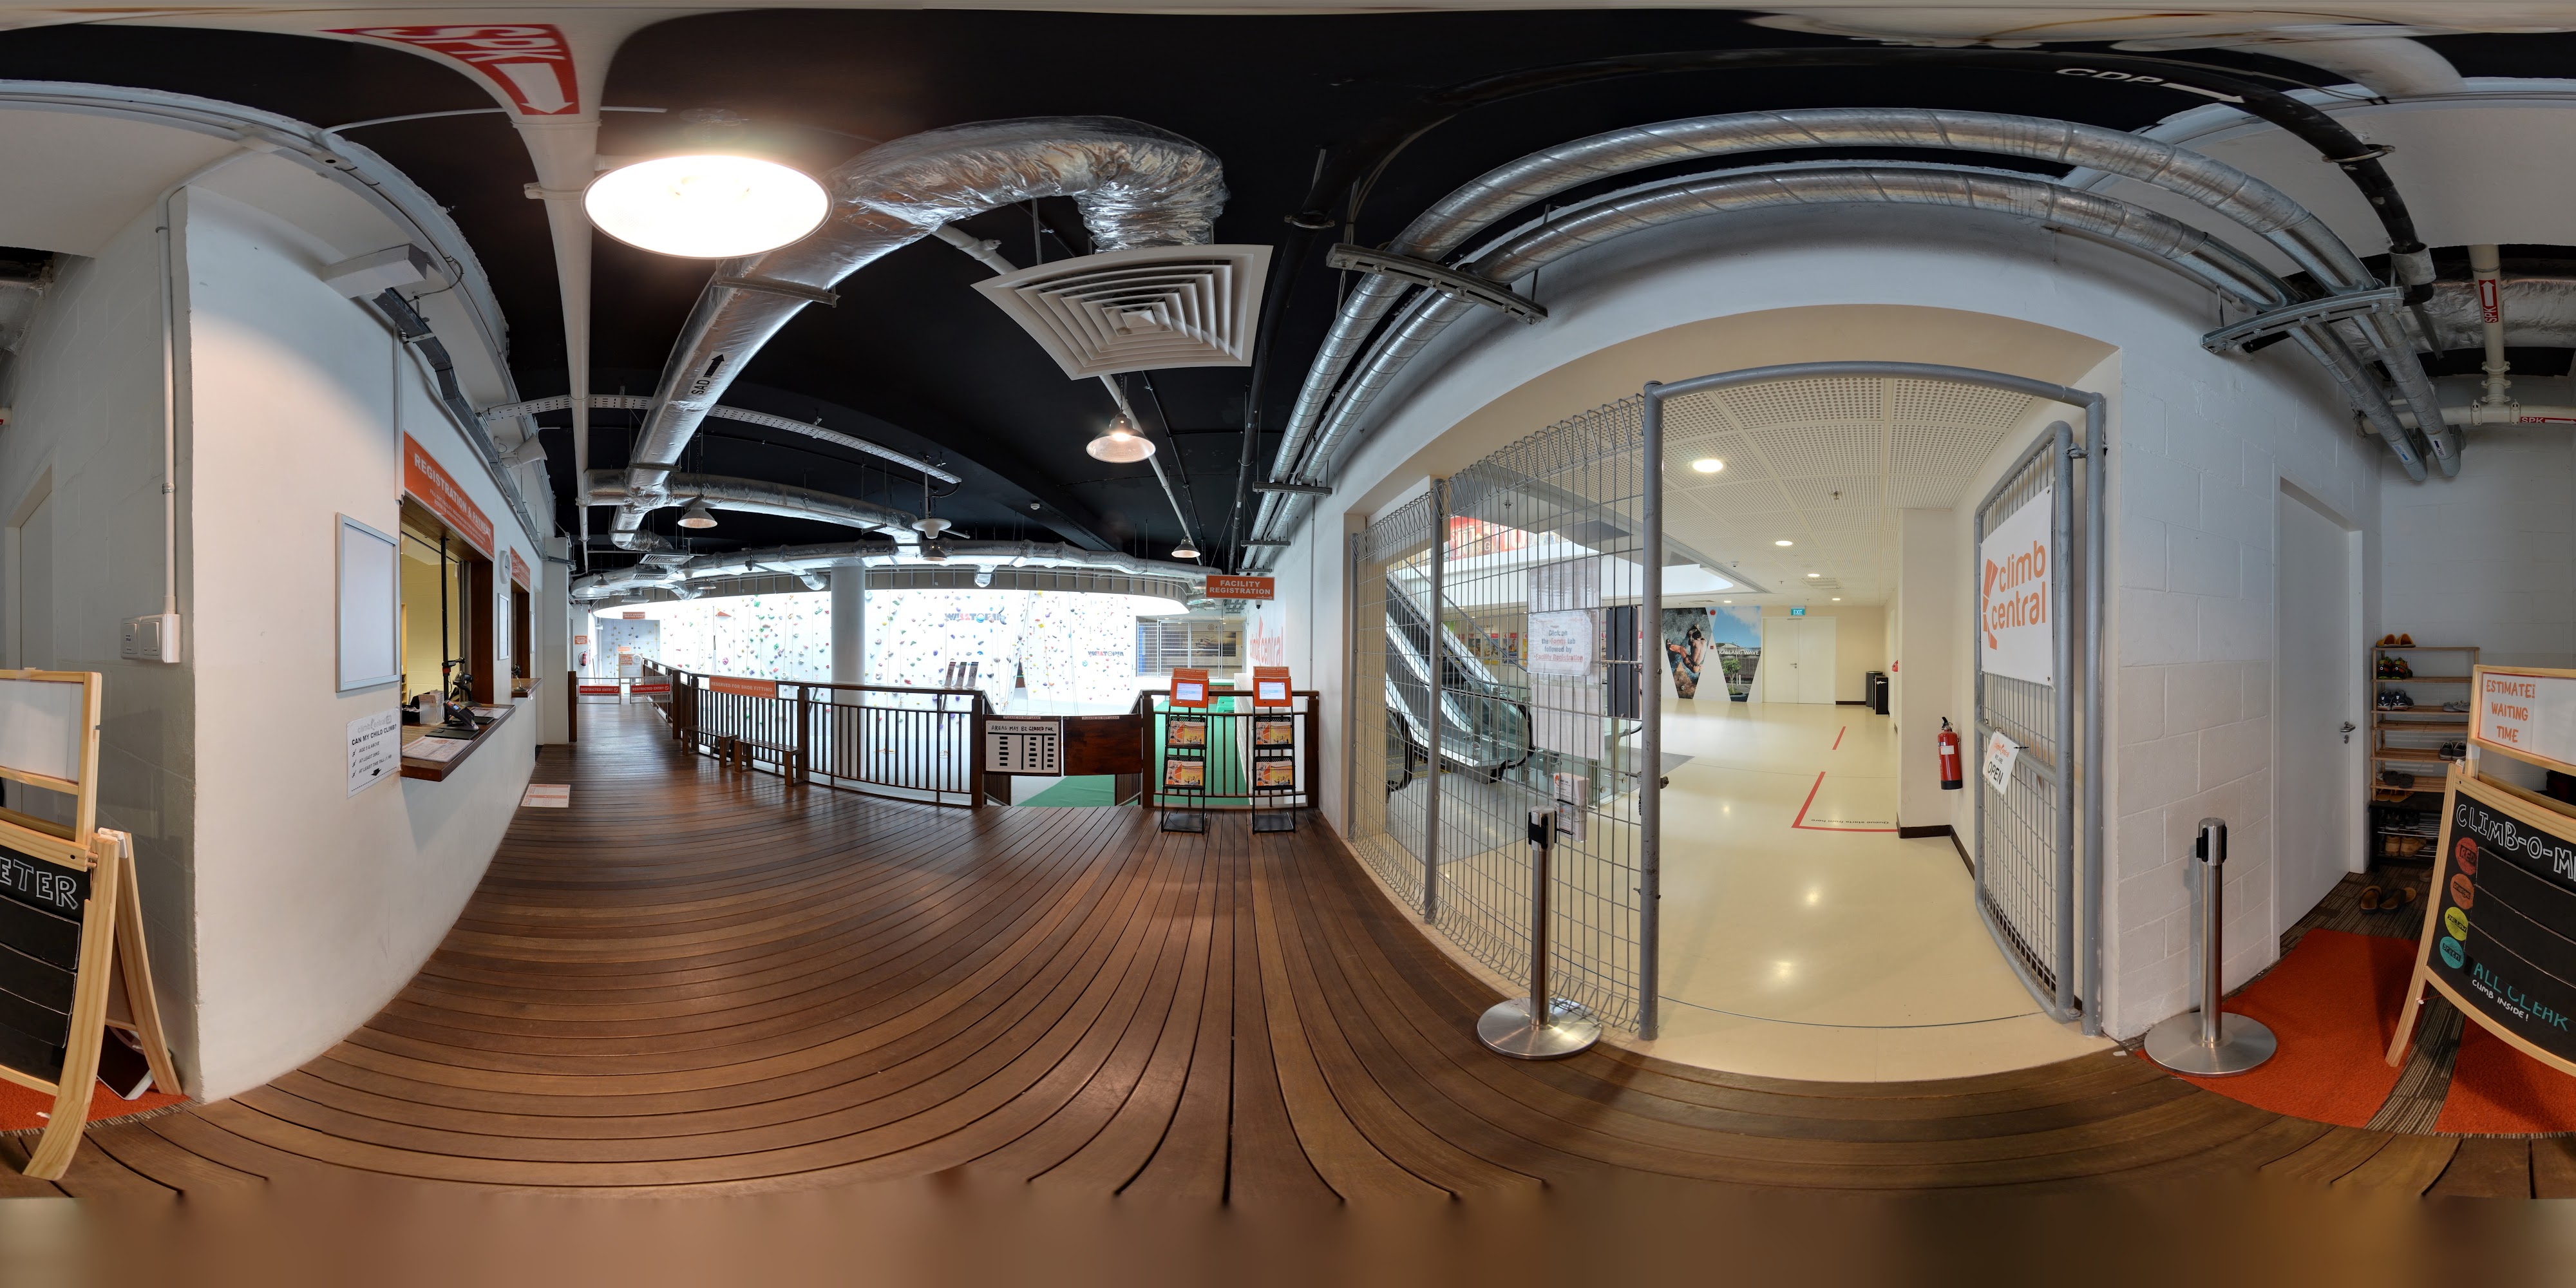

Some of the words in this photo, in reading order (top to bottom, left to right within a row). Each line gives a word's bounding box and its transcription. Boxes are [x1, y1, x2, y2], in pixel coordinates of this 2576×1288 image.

[359, 26, 567, 62] SPK
[2056, 68, 2164, 83] CDP
[2483, 307, 2497, 322] SPK
[691, 379, 710, 395] SAD
[414, 453, 467, 513] REGISTRATION
[468, 507, 472, 518] &
[473, 511, 491, 536] PAYMENT
[434, 499, 443, 510] REFER
[1999, 540, 2045, 592] climb
[1991, 581, 2045, 630] central
[1261, 626, 1283, 667] central
[2491, 702, 2528, 721] WAITING
[352, 737, 361, 745] CAN
[370, 729, 383, 738] CHILD
[384, 724, 397, 734] CLIMB?
[2497, 726, 2519, 743] TIME
[1988, 761, 2003, 784] OPEN
[2456, 804, 2576, 882] CLIMB-O-M
[2461, 848, 2476, 864] RED
[0, 856, 79, 909] ETER
[2453, 882, 2470, 898] orange
[2448, 914, 2467, 932] yellow
[2443, 943, 2461, 961] green
[2474, 963, 2501, 993] ALL
[2472, 980, 2494, 998] CLIMB
